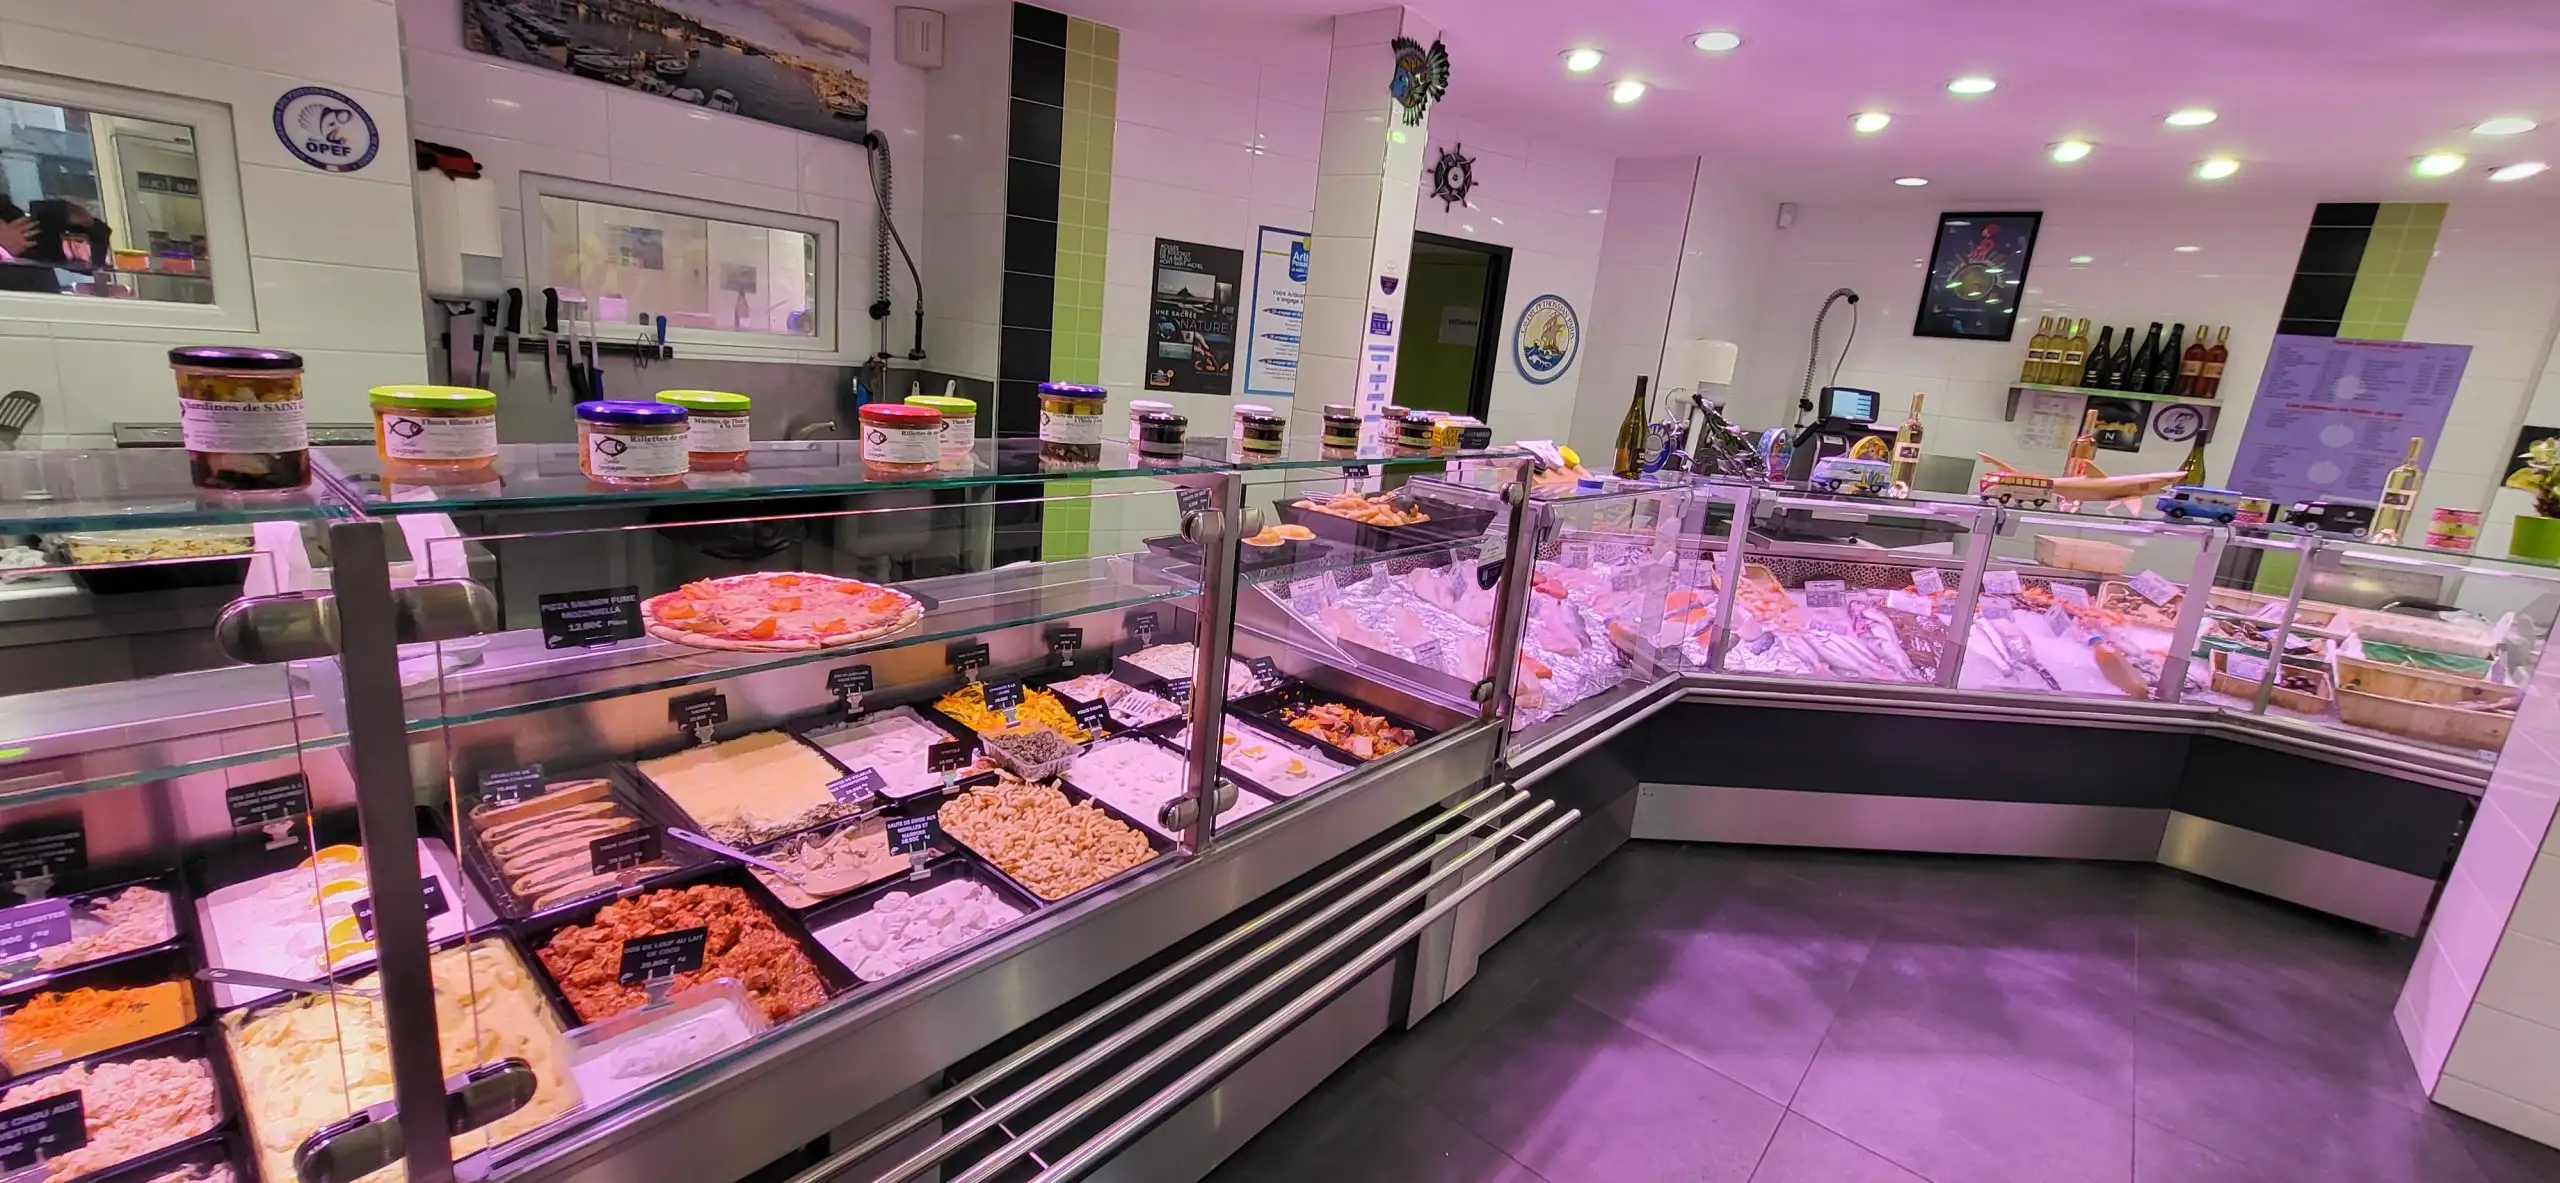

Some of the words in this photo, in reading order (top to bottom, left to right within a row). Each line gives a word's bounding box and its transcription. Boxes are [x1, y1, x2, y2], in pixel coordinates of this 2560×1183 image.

[305, 141, 351, 157] OPEF
[1180, 319, 1228, 334] NATURE
[243, 403, 260, 412] de
[693, 417, 719, 425] Miettes
[2105, 431, 2115, 440] N
[926, 814, 936, 822] AUX
[642, 943, 653, 951] DE
[654, 939, 675, 949] LOUP
[675, 937, 687, 945] AU
[687, 934, 704, 942] LAIT
[659, 946, 680, 956] COCO
